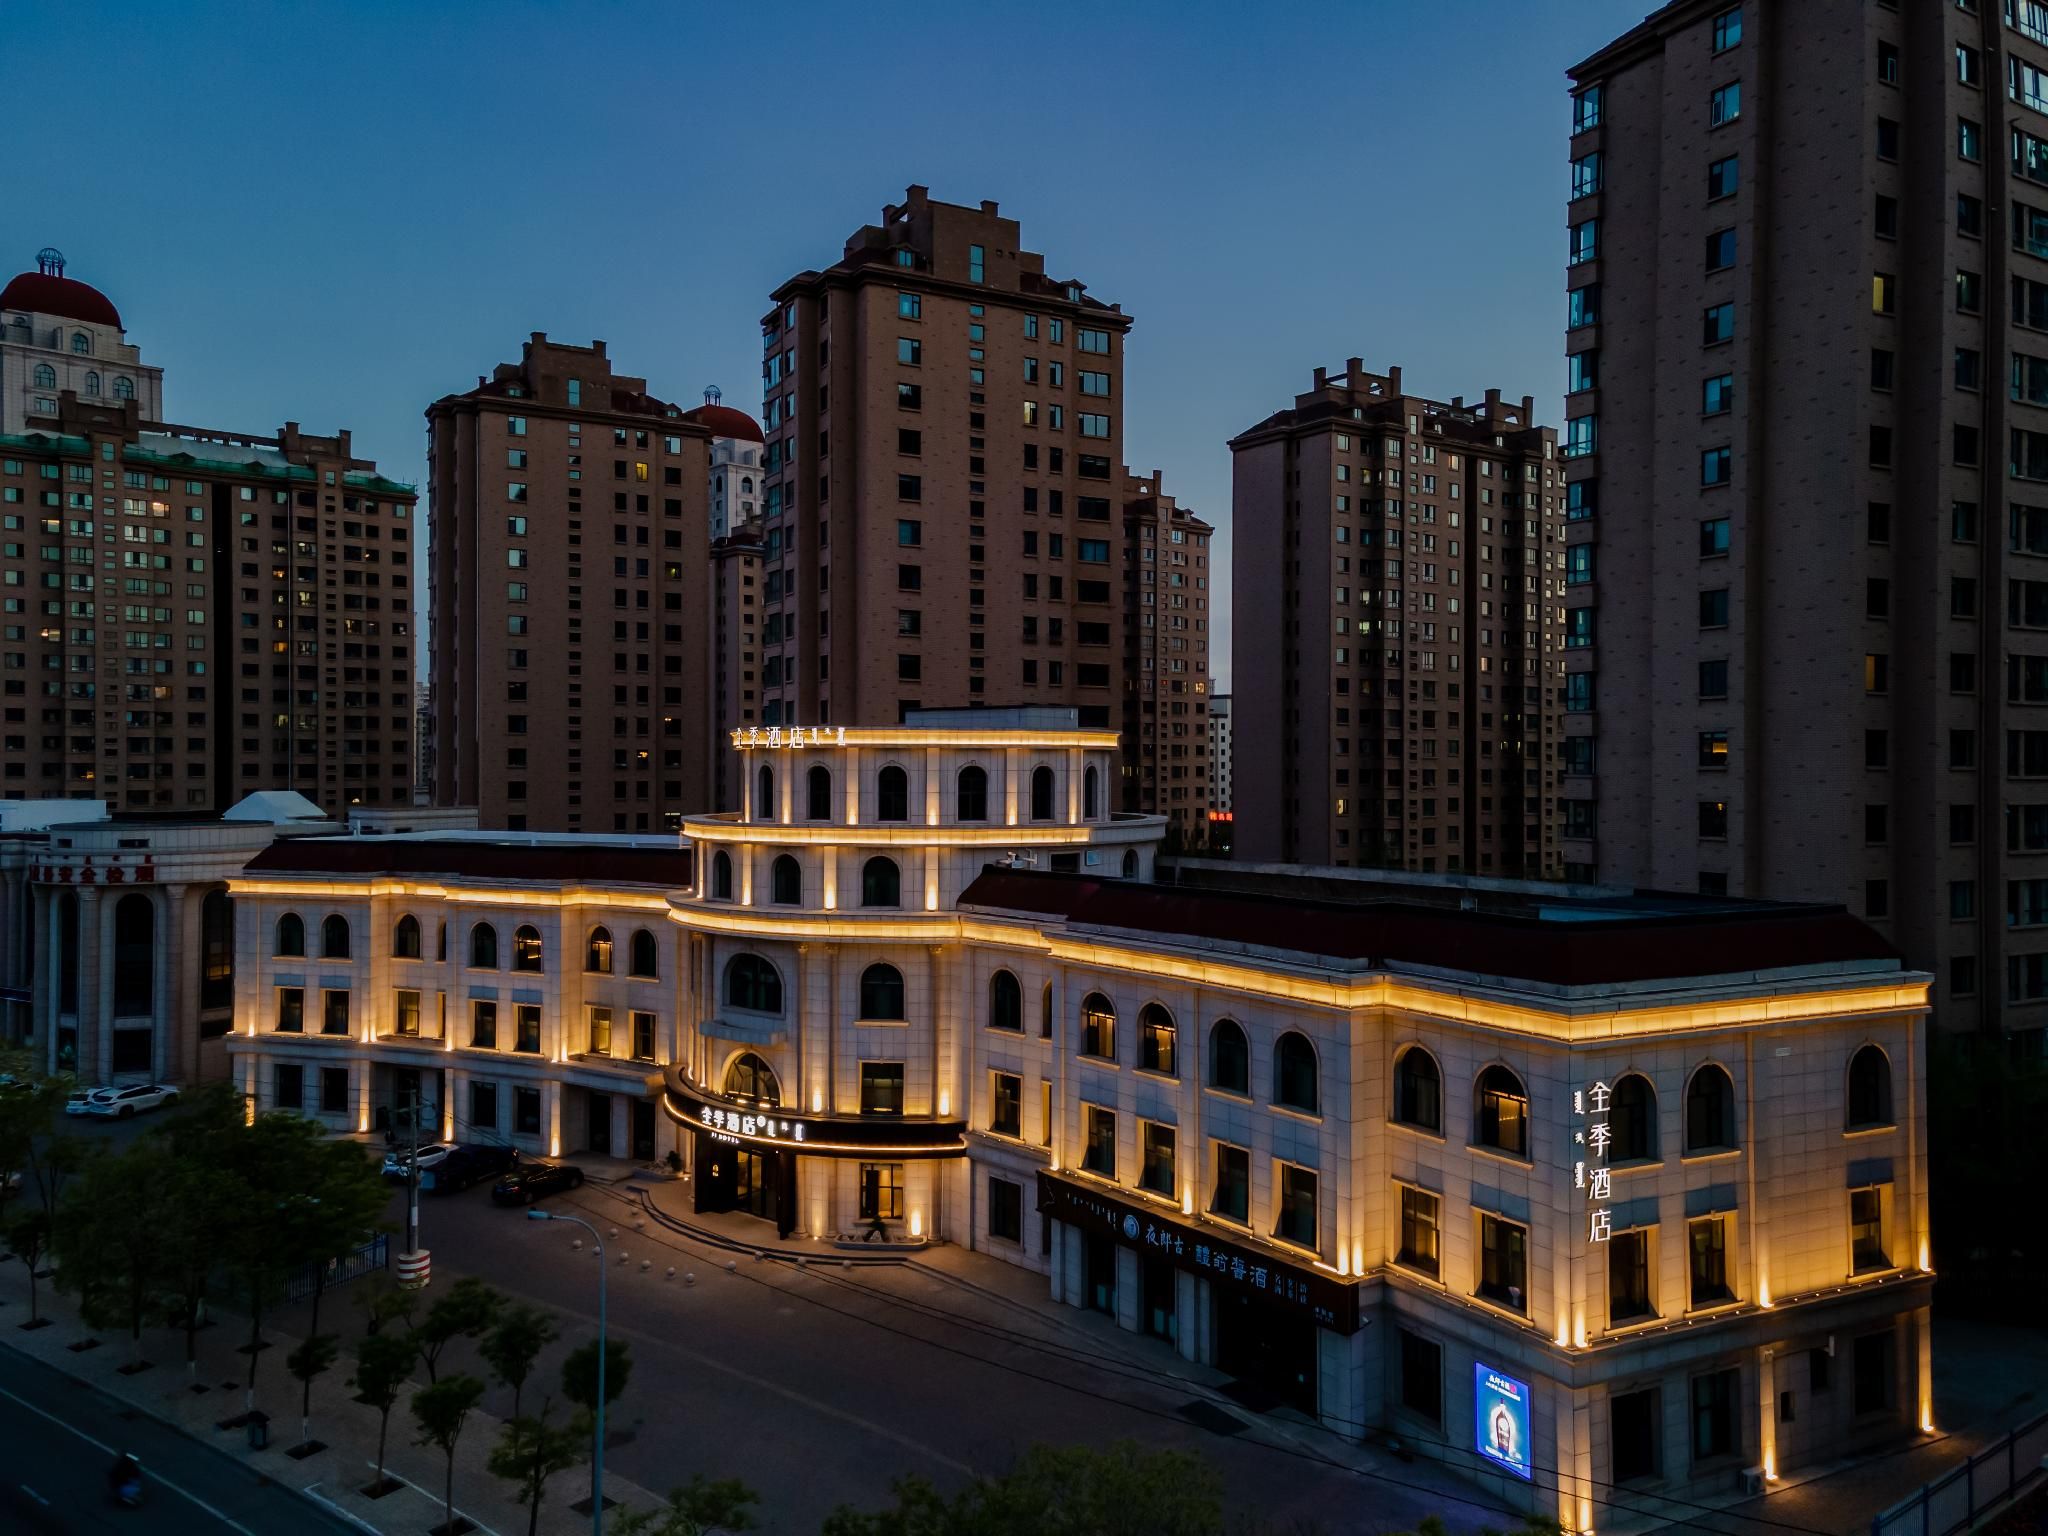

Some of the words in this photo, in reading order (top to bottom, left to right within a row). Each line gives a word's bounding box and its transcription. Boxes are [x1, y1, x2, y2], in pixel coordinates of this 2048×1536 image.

[736, 726, 805, 749] 全季酒店
[701, 1106, 755, 1136] 全季酒店
[718, 1133, 740, 1144] HOTEL
[1588, 1081, 1611, 1243] 全季酒店
[1145, 1223, 1185, 1256] 夜郎古
